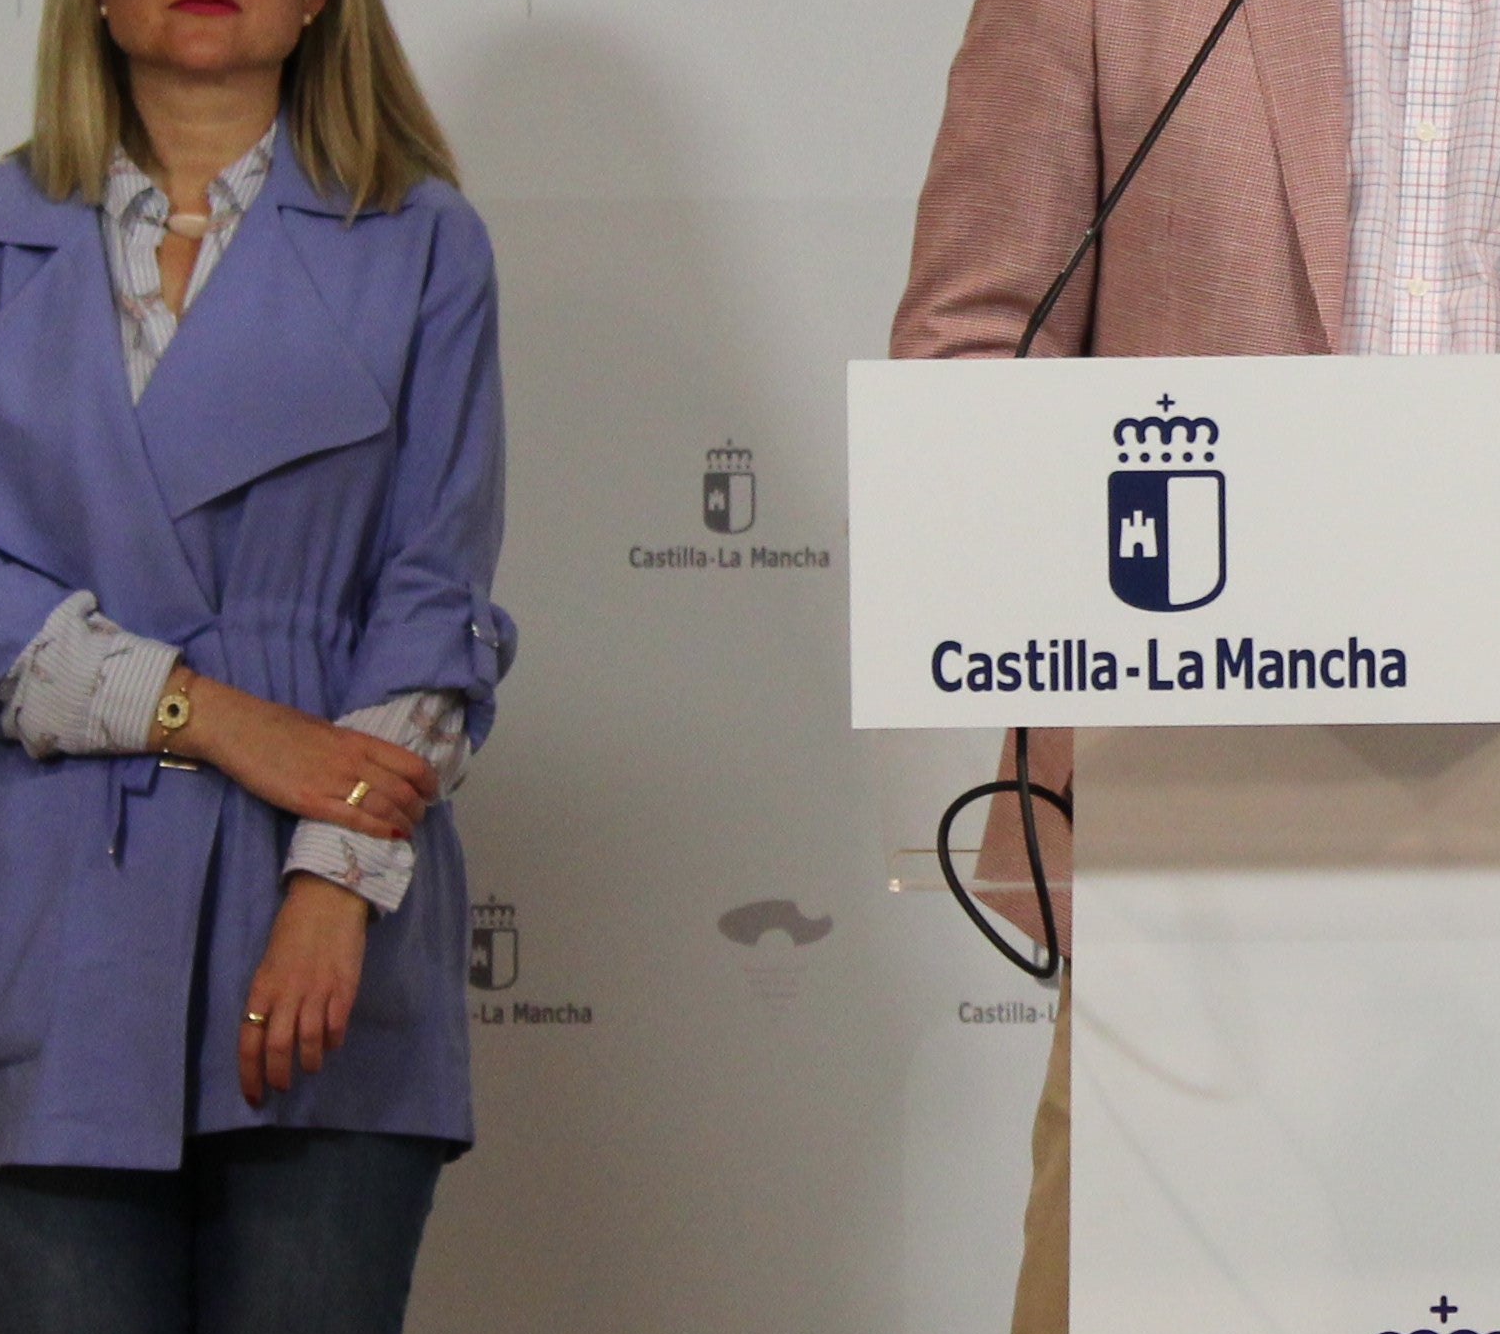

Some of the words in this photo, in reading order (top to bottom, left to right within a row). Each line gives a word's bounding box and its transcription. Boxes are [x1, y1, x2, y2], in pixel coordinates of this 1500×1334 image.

[628, 545, 742, 569] Castilla-La
[750, 546, 830, 568] Mancha
[512, 1002, 593, 1025] Mancha
[957, 1000, 1057, 1025] Castilla-L
